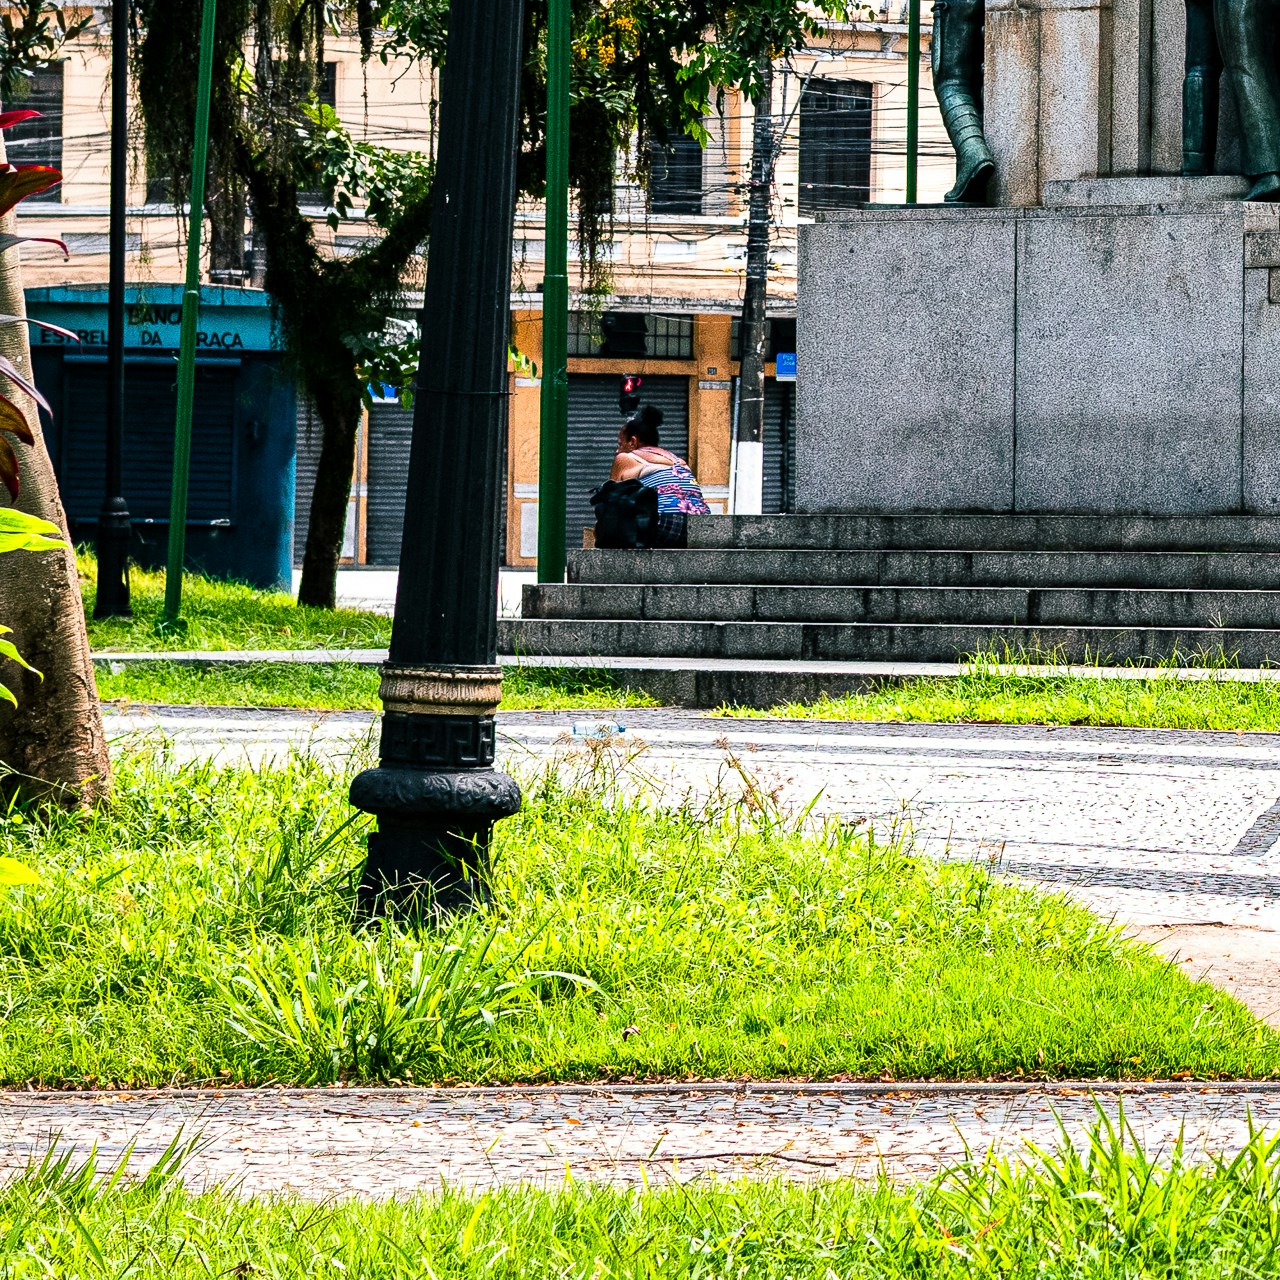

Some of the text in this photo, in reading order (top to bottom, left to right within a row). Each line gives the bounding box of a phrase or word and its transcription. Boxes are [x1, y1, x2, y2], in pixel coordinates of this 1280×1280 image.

[128, 308, 183, 326] BANC
[41, 329, 243, 350] ESTREL DA RAÇA
